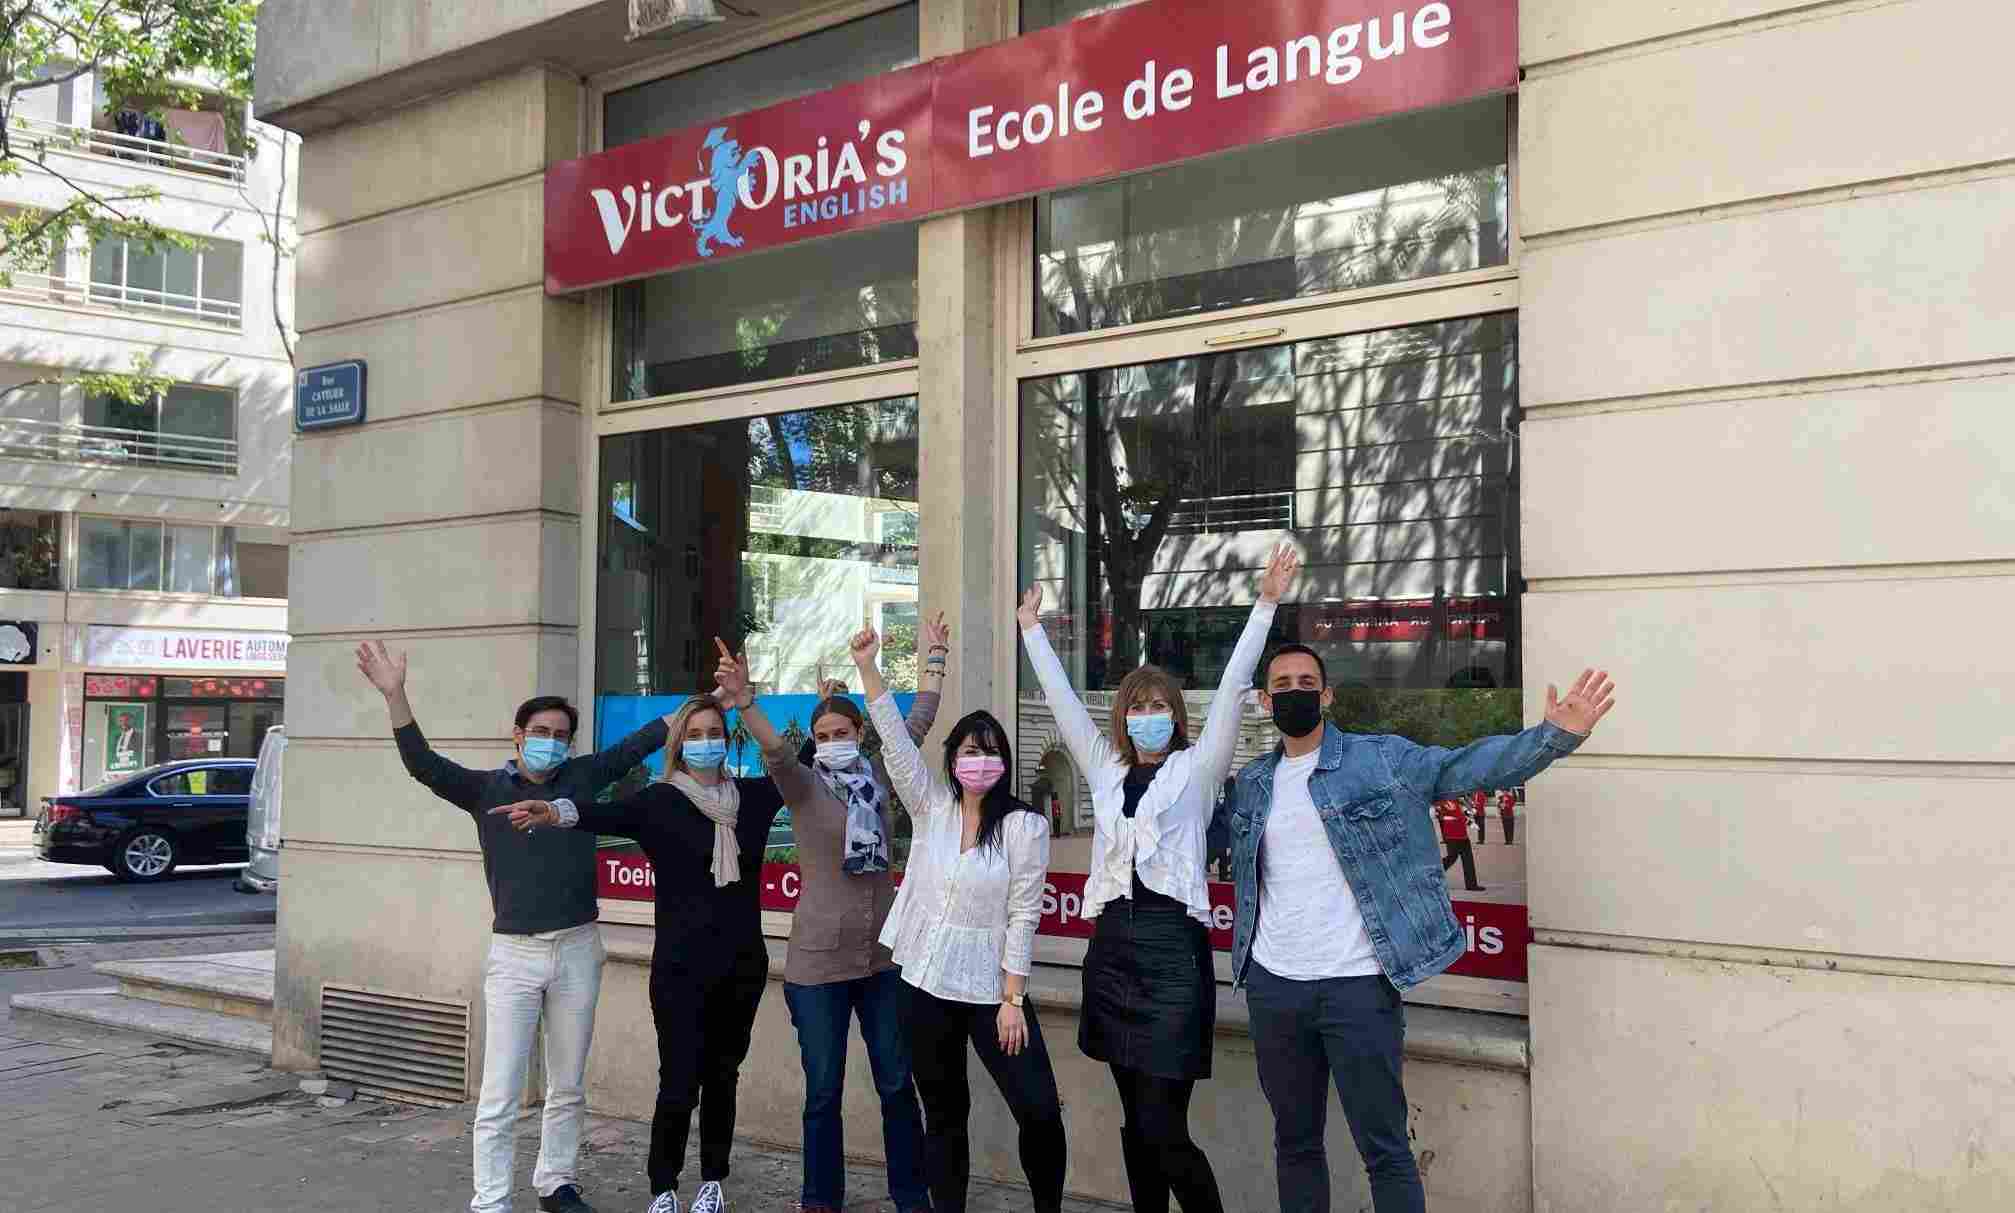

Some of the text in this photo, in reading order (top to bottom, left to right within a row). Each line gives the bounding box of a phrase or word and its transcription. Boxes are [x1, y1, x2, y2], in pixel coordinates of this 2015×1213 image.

[967, 1, 1452, 159] Ecole de Langue
[783, 179, 908, 229] ENGLISH
[163, 637, 241, 660] LAVERIE
